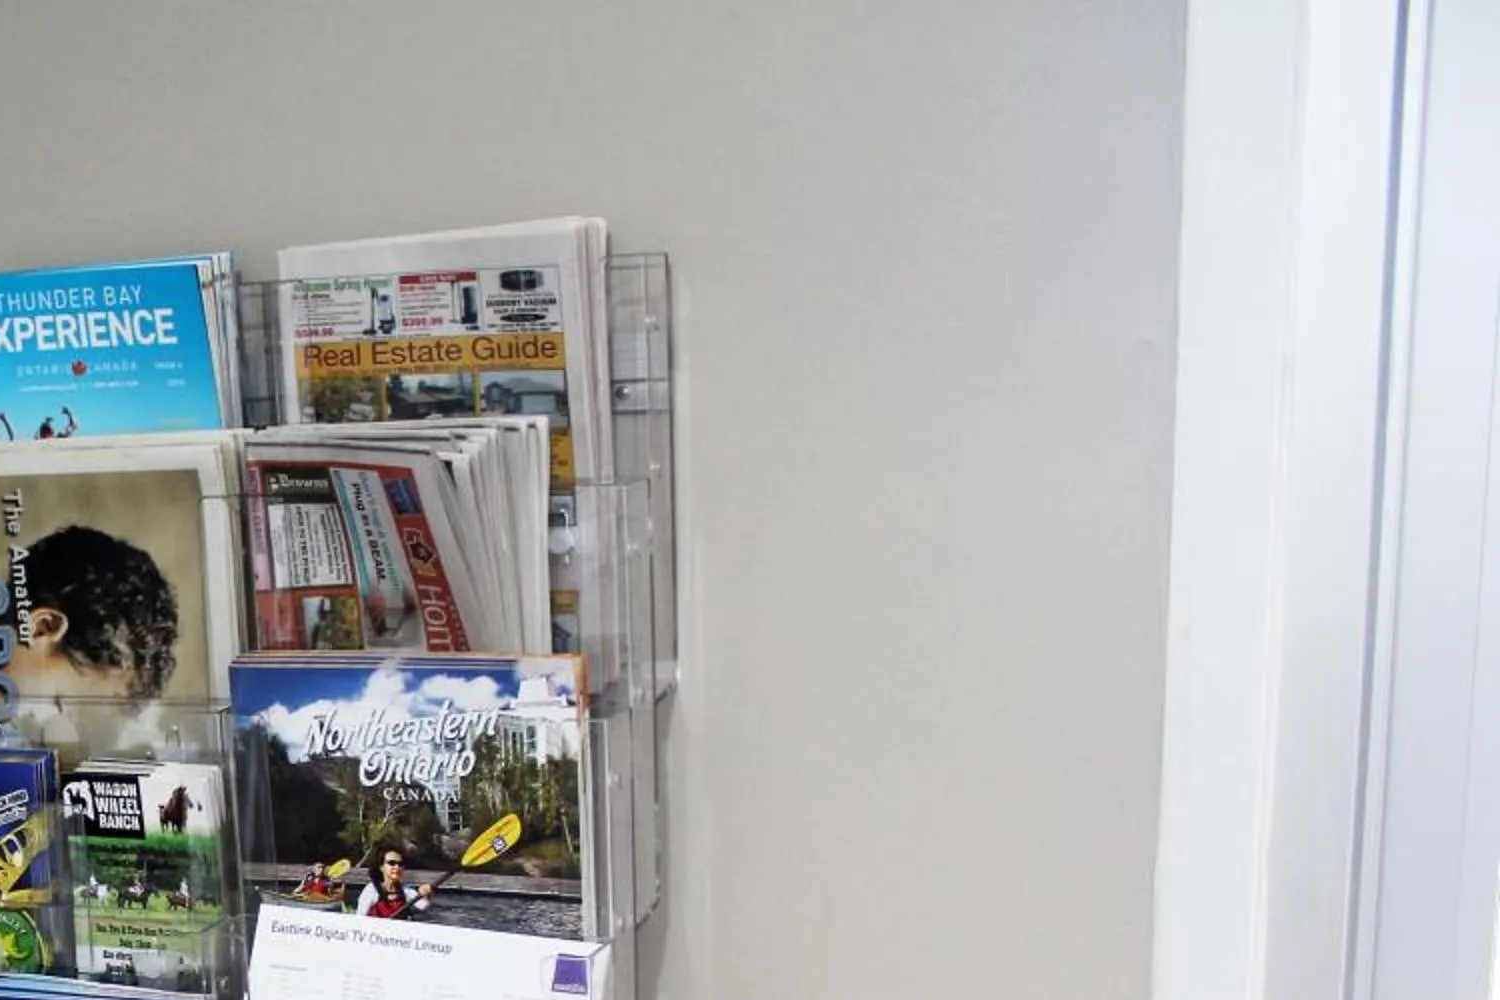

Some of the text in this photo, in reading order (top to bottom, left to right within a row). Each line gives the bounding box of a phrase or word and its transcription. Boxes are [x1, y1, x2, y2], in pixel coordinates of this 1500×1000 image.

[103, 284, 142, 307] BAY
[303, 333, 559, 369] Real Estate Guide
[1, 488, 36, 649] The Amateur
[304, 700, 502, 755] Northeastern
[359, 747, 477, 788] Ontario
[92, 781, 138, 798] WAGON
[382, 786, 462, 803] CANADA
[95, 798, 141, 815] WHEEL
[98, 815, 141, 831] RANCH
[270, 920, 454, 956] Eastlink Digital TV Channel Lineup
